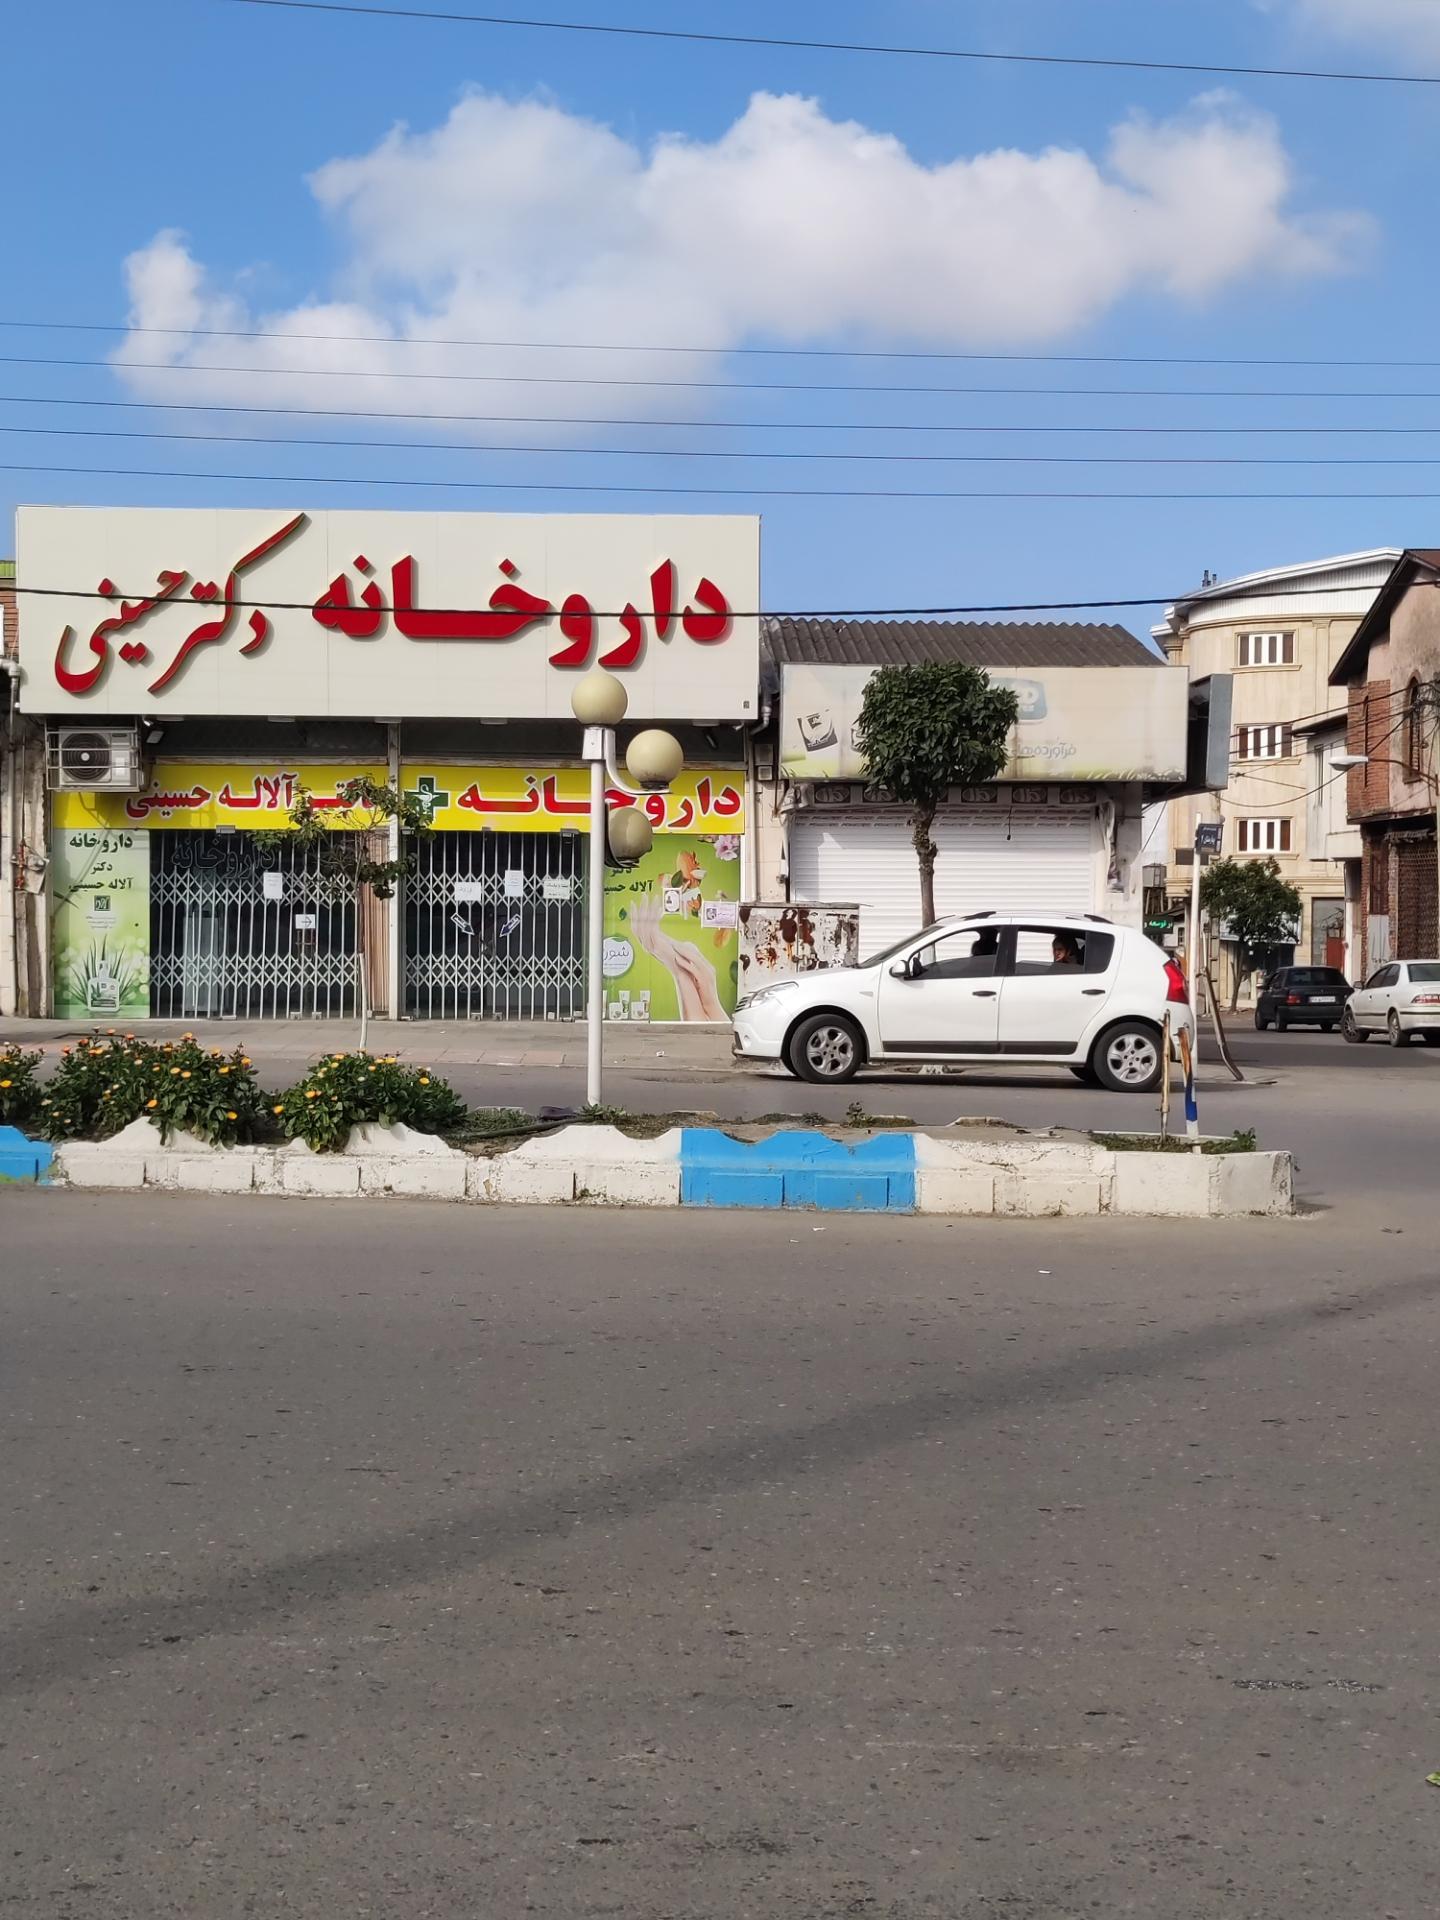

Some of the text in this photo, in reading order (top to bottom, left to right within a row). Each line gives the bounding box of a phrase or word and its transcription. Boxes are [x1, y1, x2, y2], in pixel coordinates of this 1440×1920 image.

[312, 555, 728, 667] داروخانه
[126, 780, 212, 819] حسینی
[218, 772, 297, 809] آلاله
[69, 832, 133, 853] داروخانه
[90, 861, 113, 875] دکتر
[69, 876, 134, 893] آلاله حسینی
[603, 880, 654, 895] آلاله حسی
